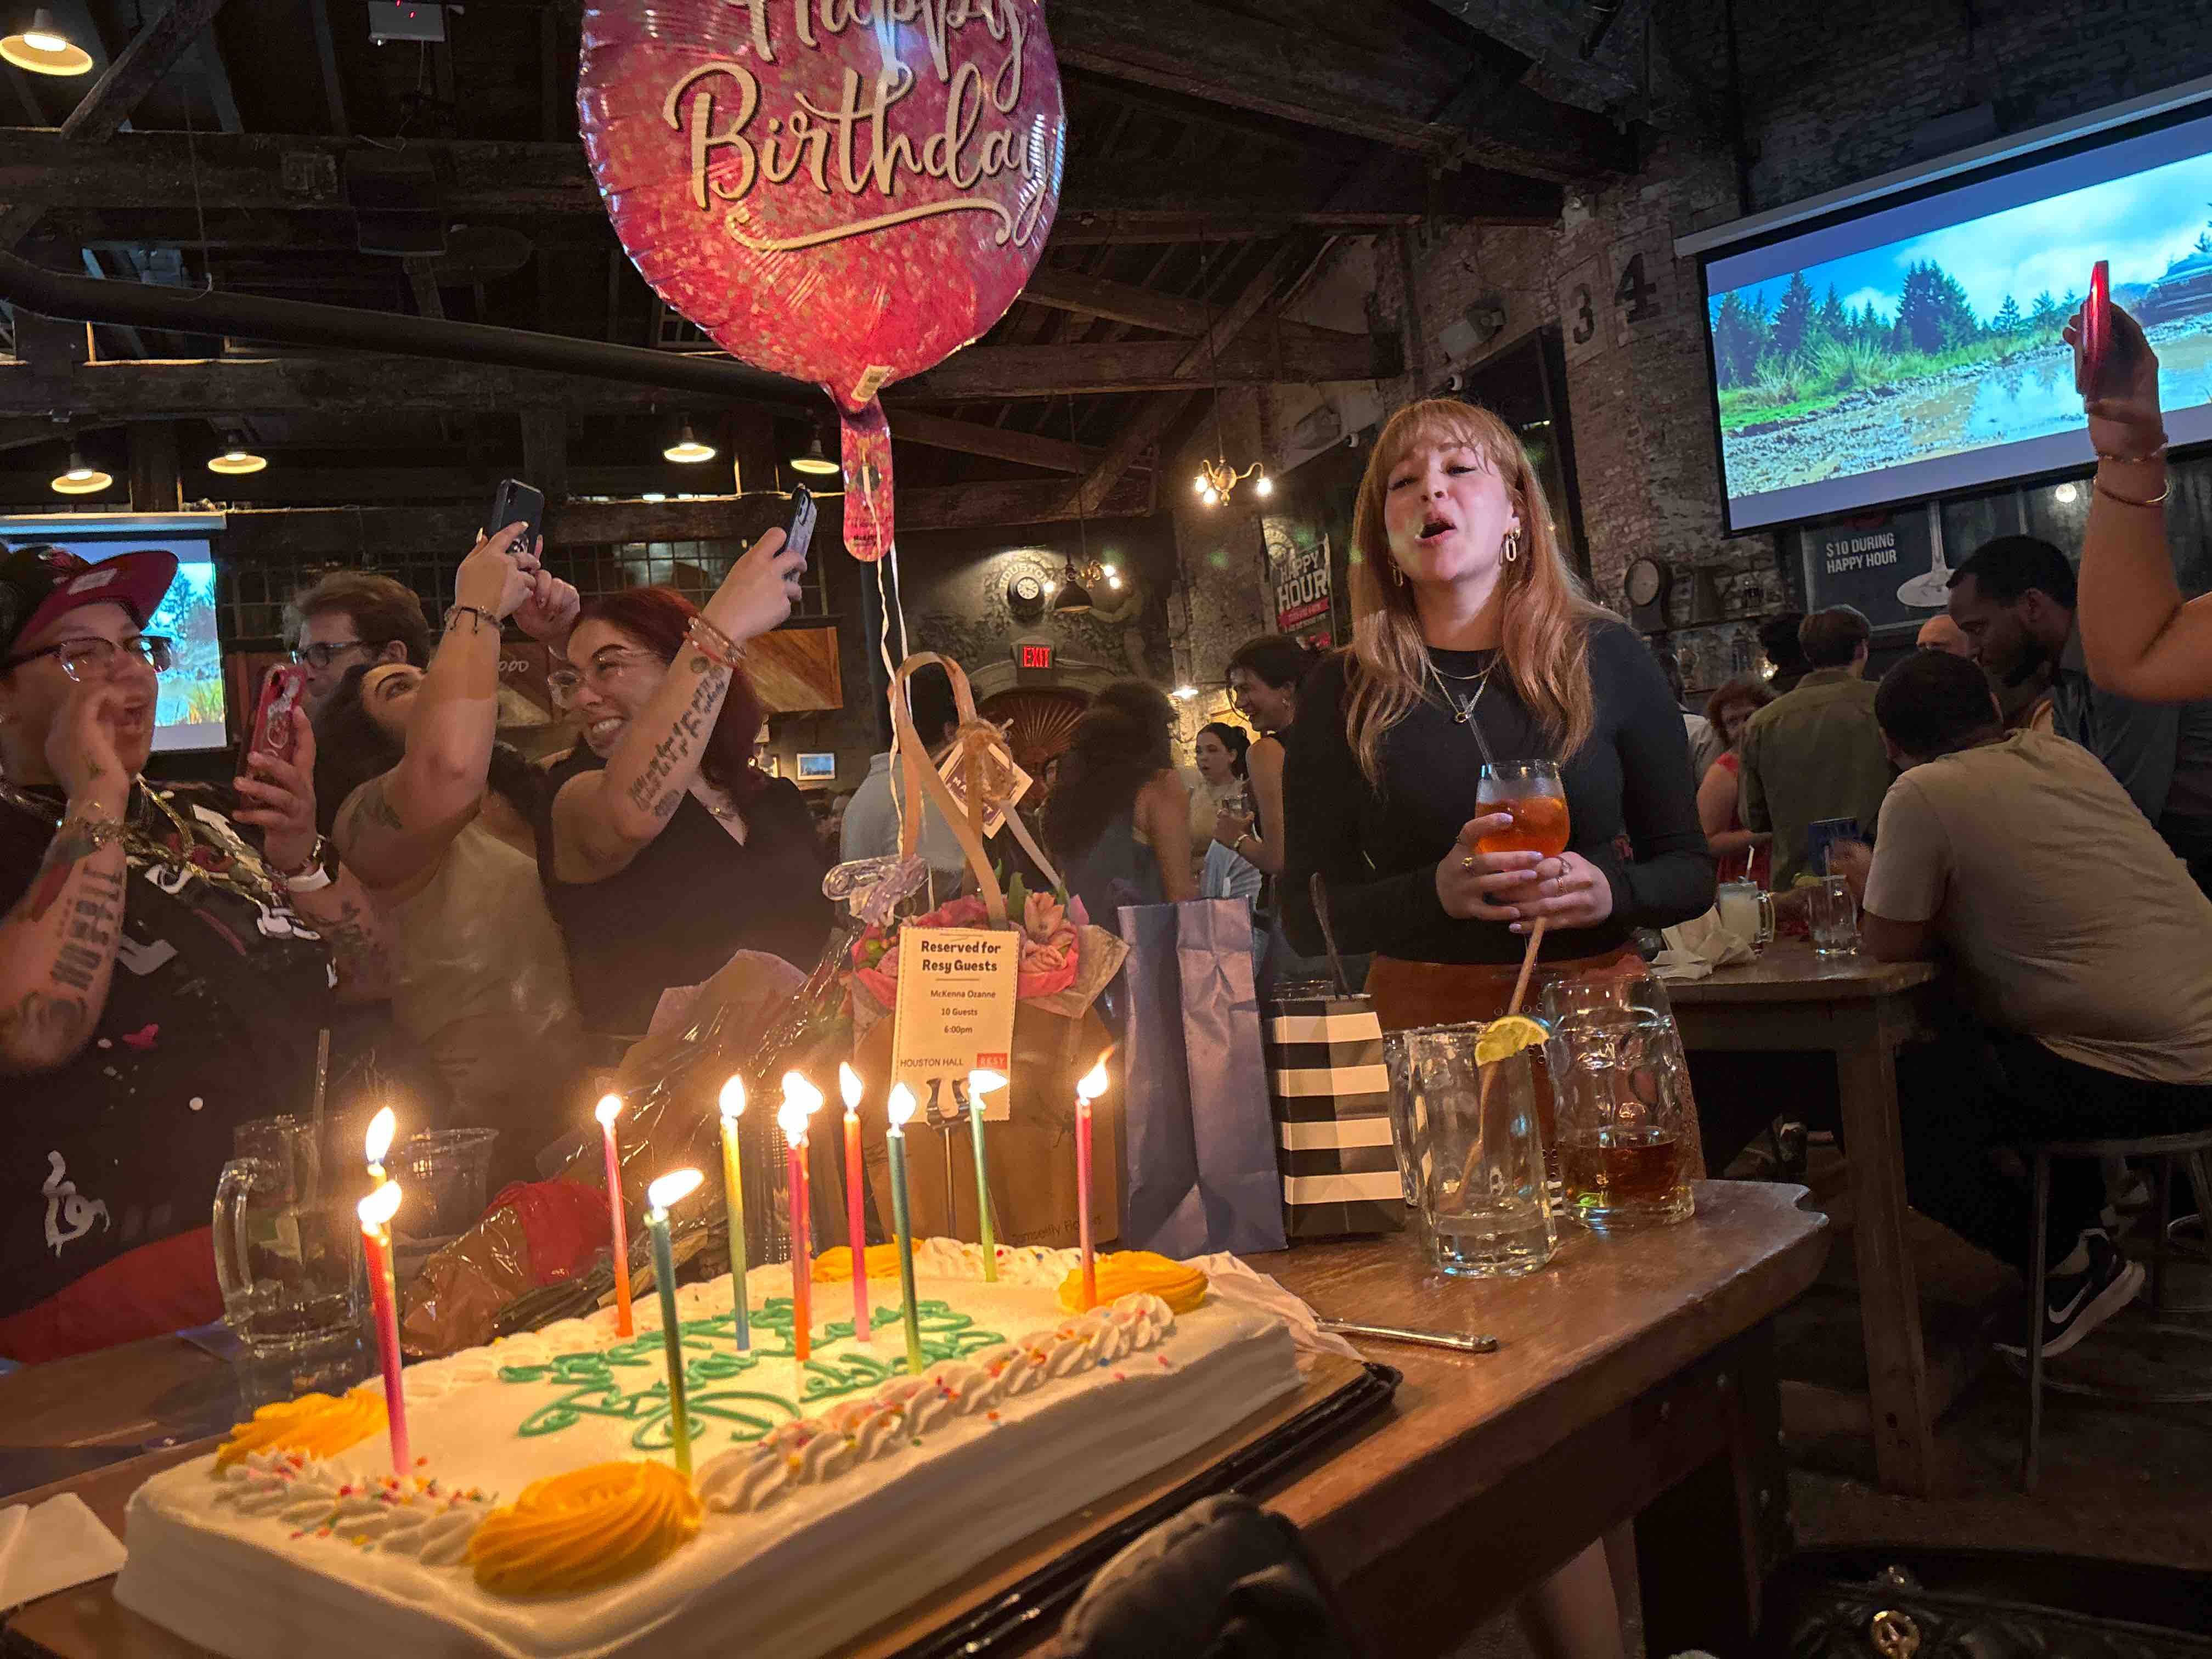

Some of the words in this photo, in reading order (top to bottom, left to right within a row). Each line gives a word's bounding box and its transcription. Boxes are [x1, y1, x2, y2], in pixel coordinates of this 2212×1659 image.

[663, 59, 1047, 248] Birthday
[1851, 532, 1895, 554] DURING
[1280, 550, 1319, 582] HAPPY
[1826, 556, 1863, 574] HAPPY
[1866, 549, 1897, 567] HOUR
[1277, 568, 1328, 613] HOUR
[1022, 646, 1051, 668] EXIT
[921, 940, 980, 953] Reserved
[981, 941, 1001, 955] for
[922, 958, 952, 974] Resy
[954, 959, 998, 972] Guests
[930, 989, 966, 998] McKenna
[967, 990, 996, 998] Ozanne
[952, 1008, 978, 1016] Guests
[944, 1025, 973, 1034] 6:00pm
[900, 1058, 941, 1068] HOUSTON
[942, 1058, 964, 1066] HALL
[980, 1057, 1005, 1068] RESY
